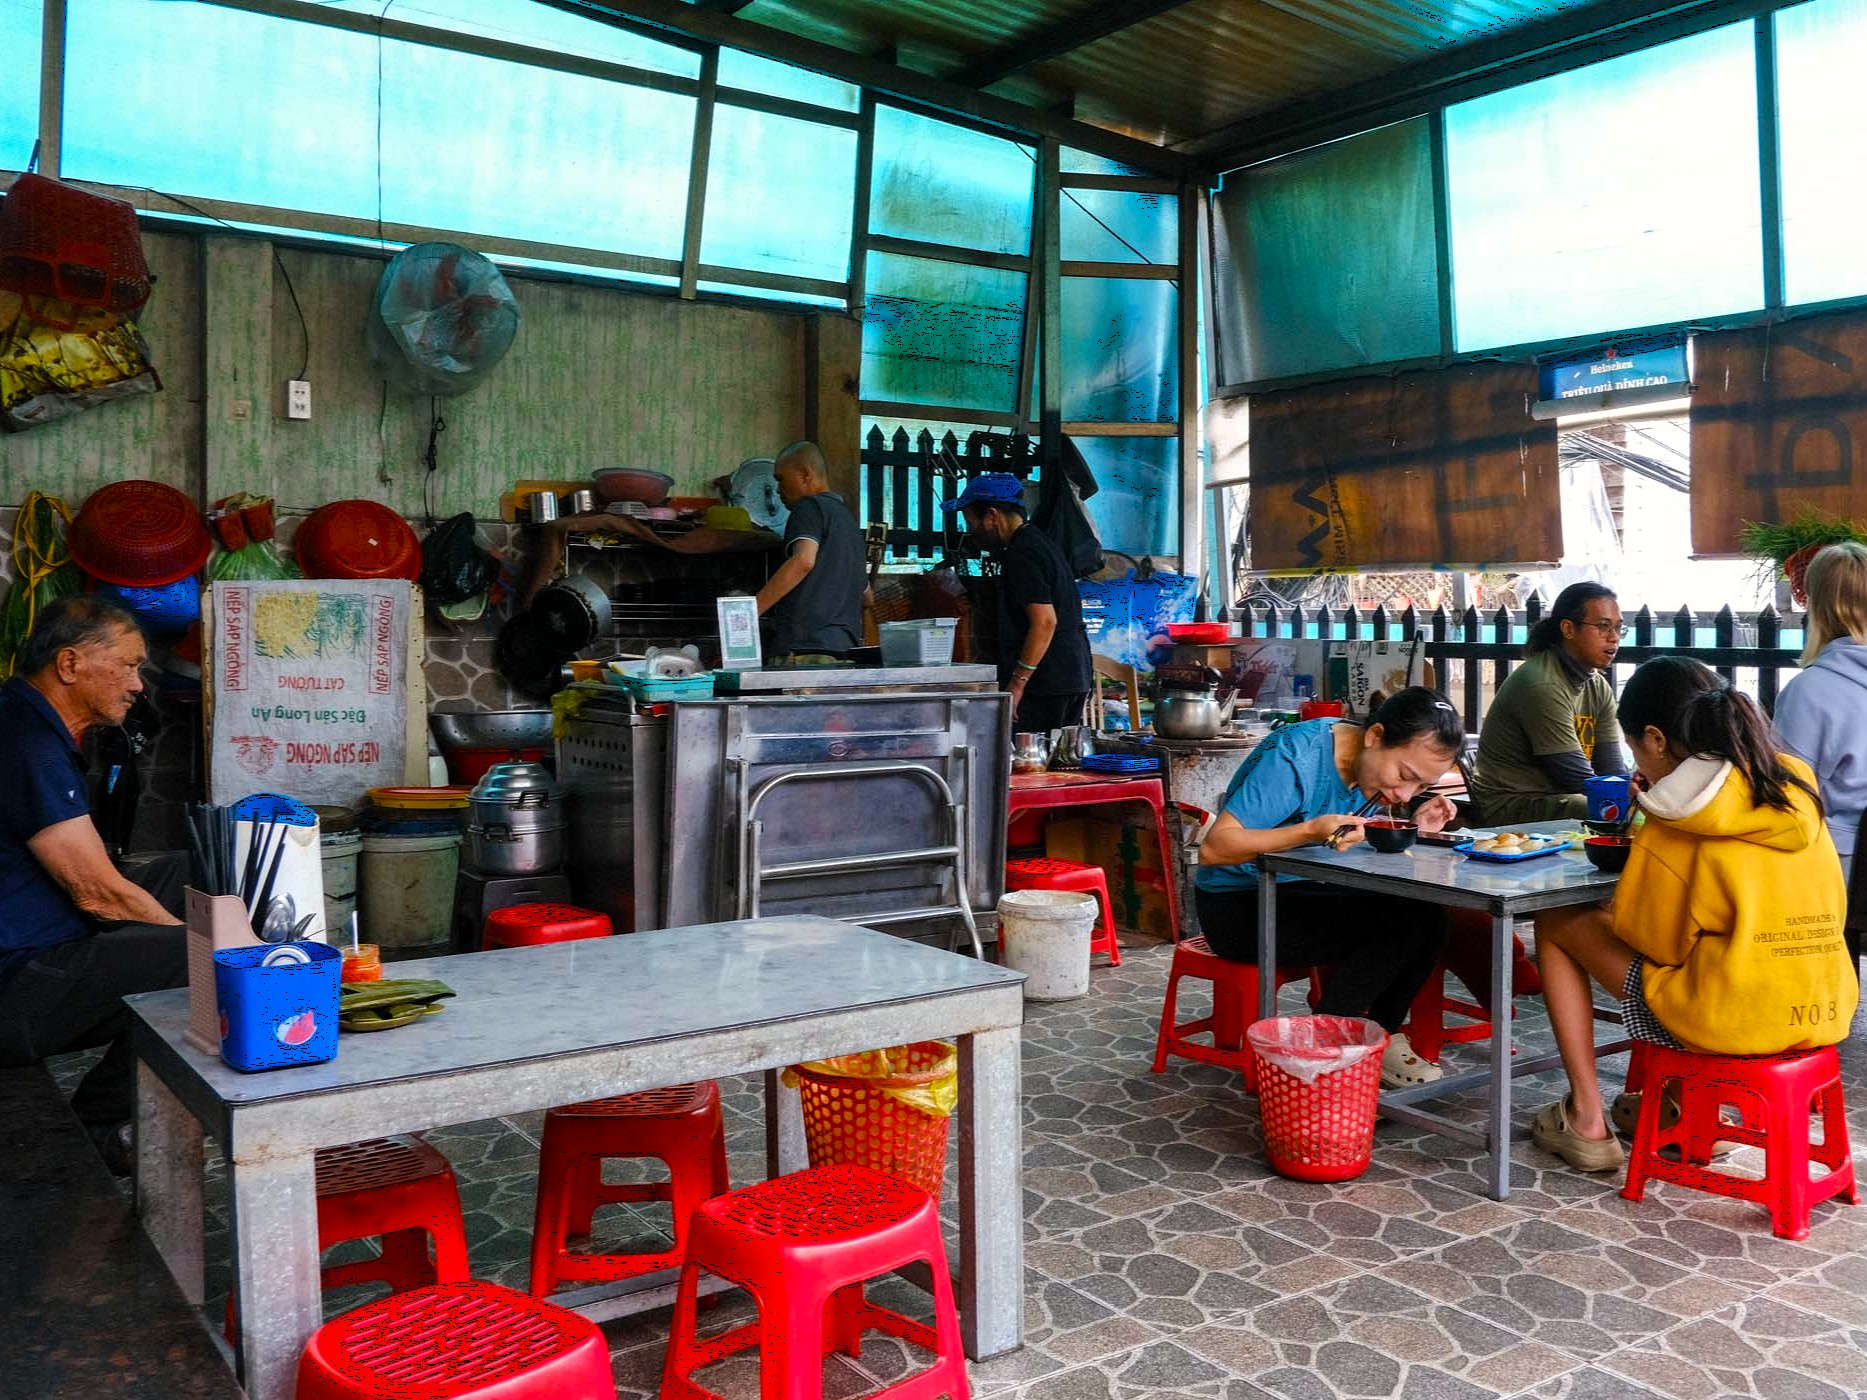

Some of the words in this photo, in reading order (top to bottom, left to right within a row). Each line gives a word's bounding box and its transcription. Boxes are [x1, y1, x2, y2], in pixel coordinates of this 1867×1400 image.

[1590, 361, 1633, 374] Heineken
[1646, 375, 1668, 387] CAO
[1356, 662, 1365, 706] SAIGON
[251, 708, 271, 722] An
[275, 705, 311, 724] Long
[315, 710, 338, 725] Sản
[341, 706, 366, 724] Đặc
[1753, 931, 1804, 943] ORIGINAL
